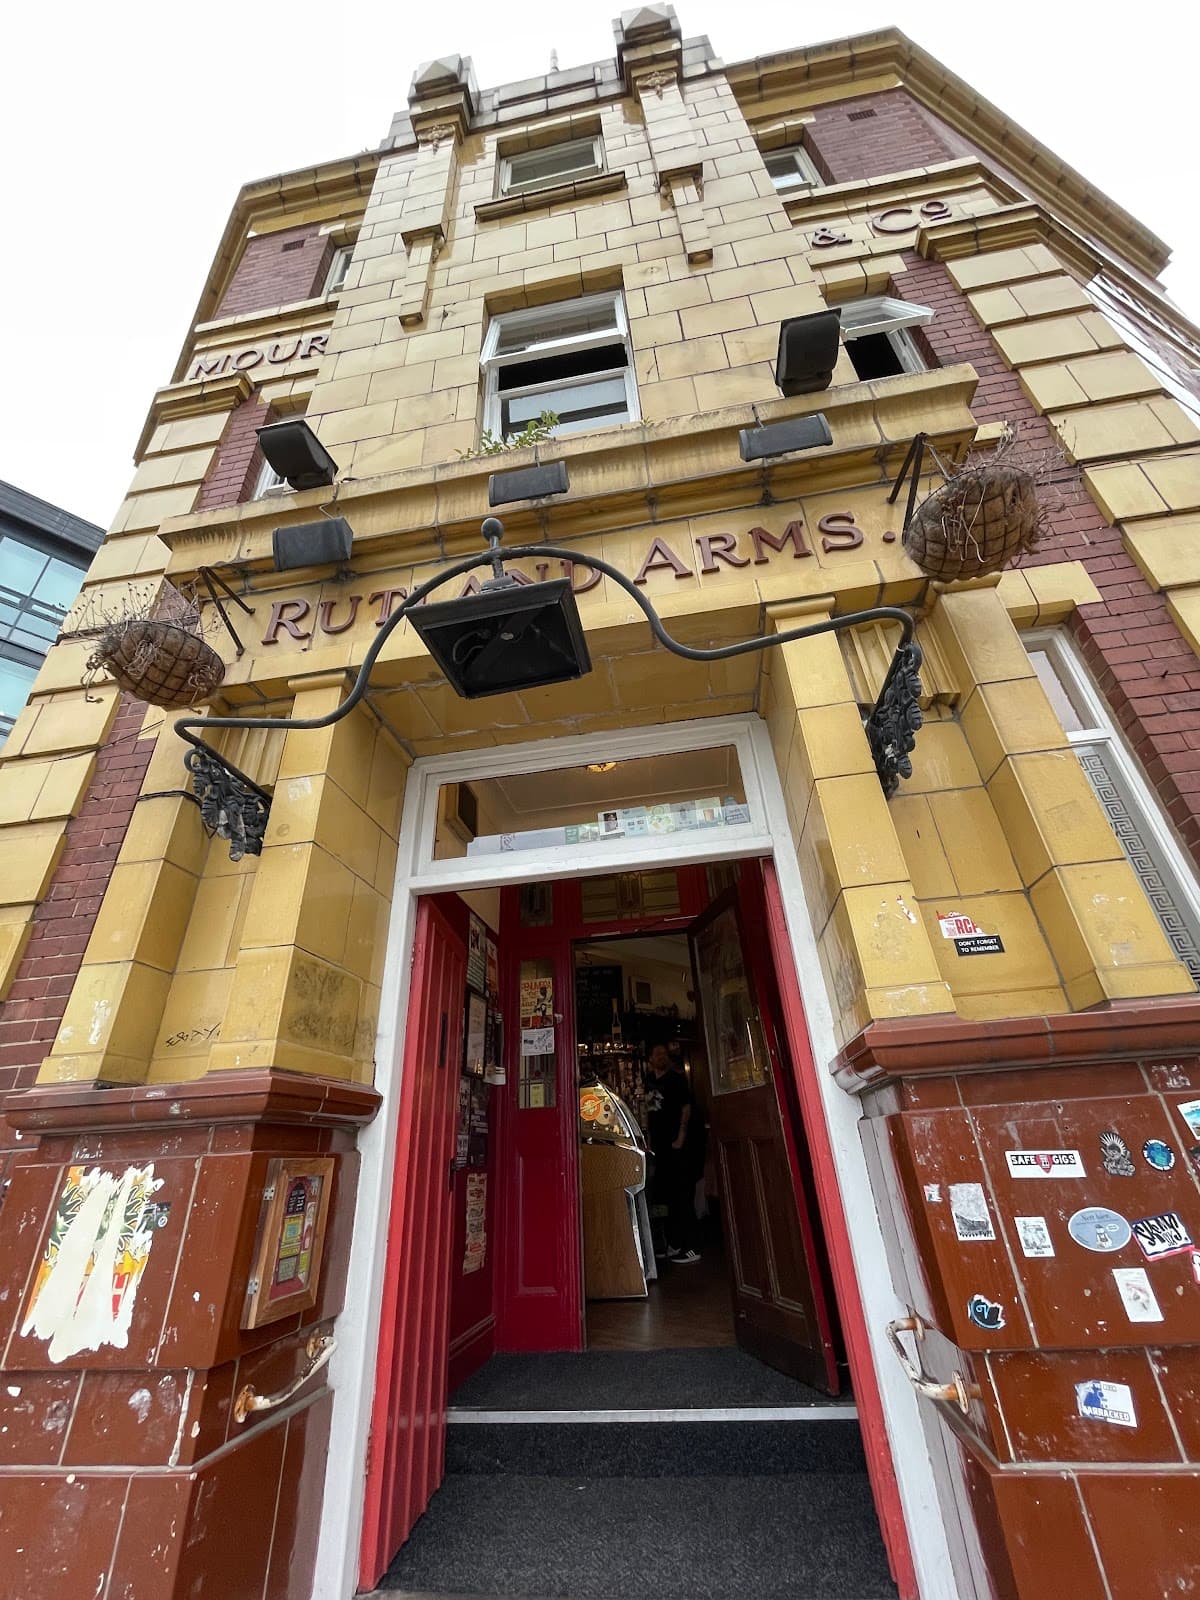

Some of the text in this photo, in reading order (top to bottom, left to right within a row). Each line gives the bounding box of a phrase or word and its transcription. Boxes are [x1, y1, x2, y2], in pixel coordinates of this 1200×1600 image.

[811, 226, 853, 249] &
[189, 335, 329, 380] MOUR
[970, 944, 1000, 952] REMEMBER
[1011, 1154, 1075, 1165] SAFE GIGS
